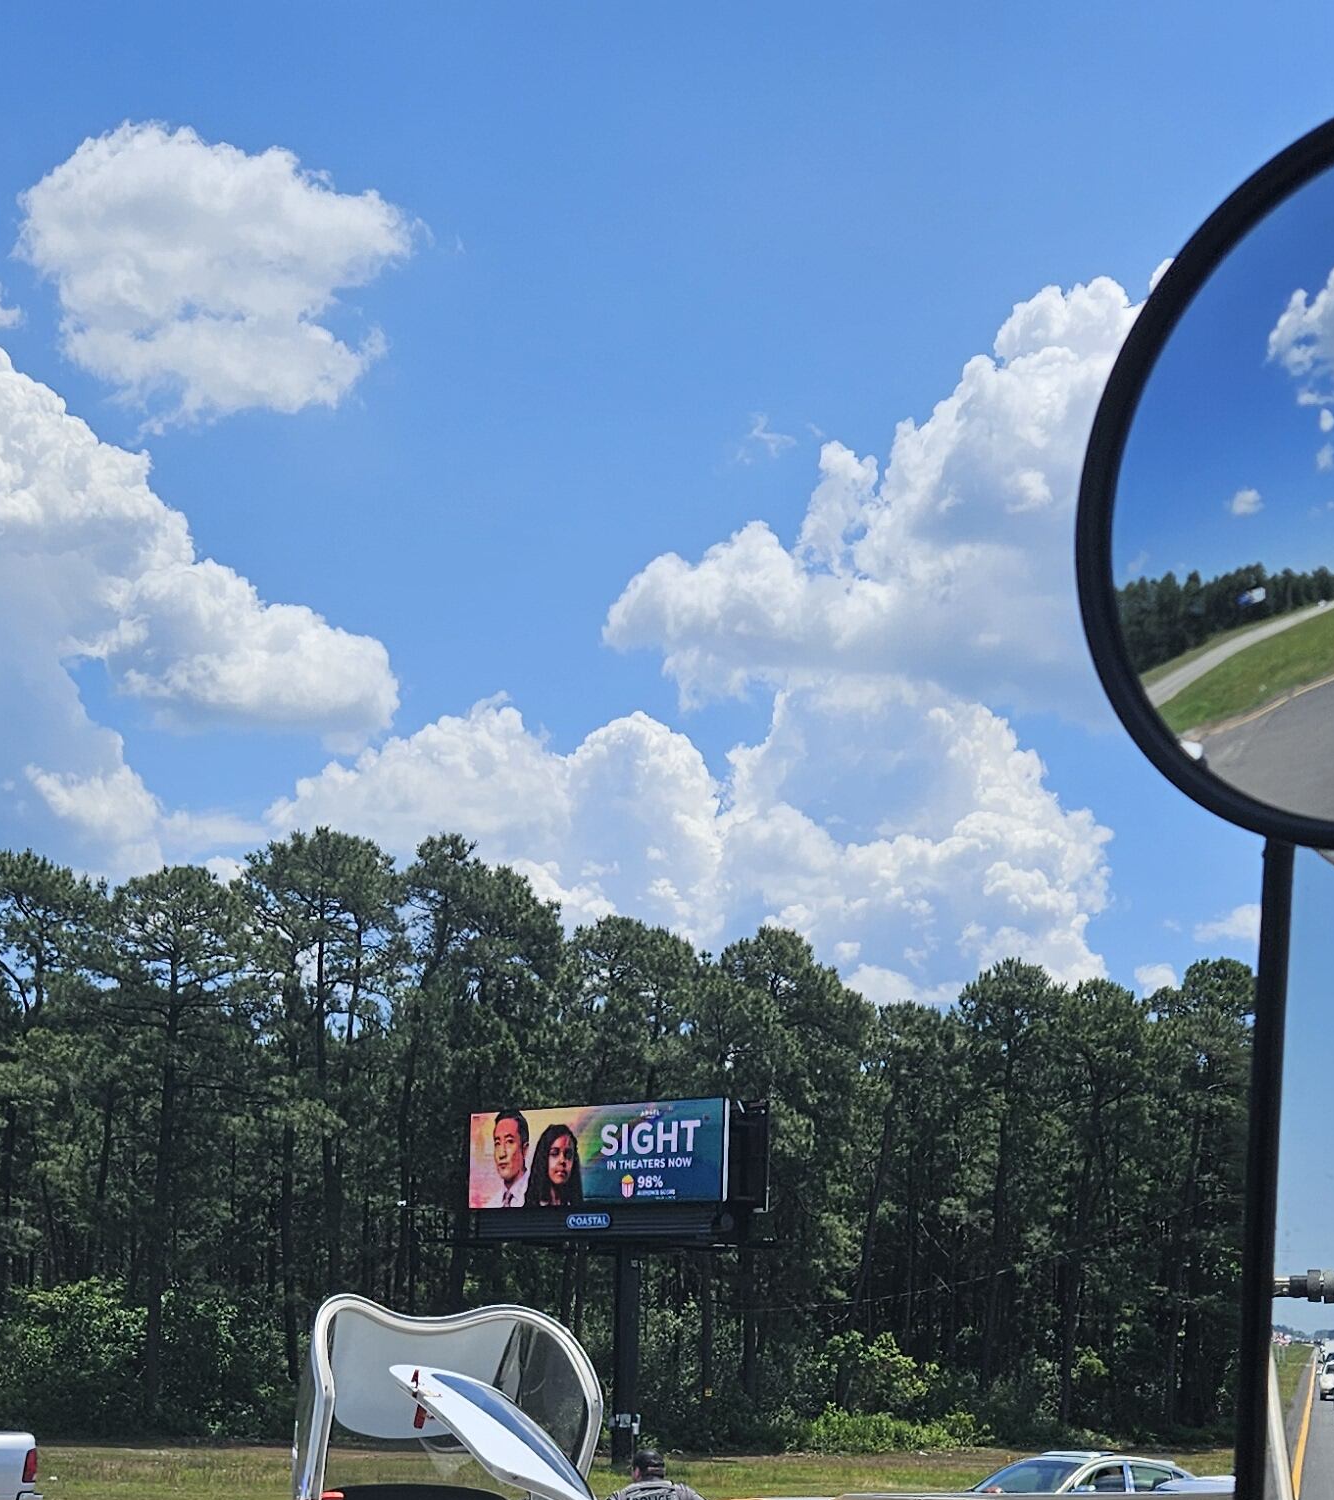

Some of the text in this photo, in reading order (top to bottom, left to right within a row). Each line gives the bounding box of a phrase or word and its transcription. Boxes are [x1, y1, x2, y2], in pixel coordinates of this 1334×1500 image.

[601, 1119, 701, 1156] SIGHT
[607, 1156, 693, 1170] IN THEATERS NOW
[637, 1175, 664, 1188] 98%
[569, 1216, 607, 1226] COASTAL
